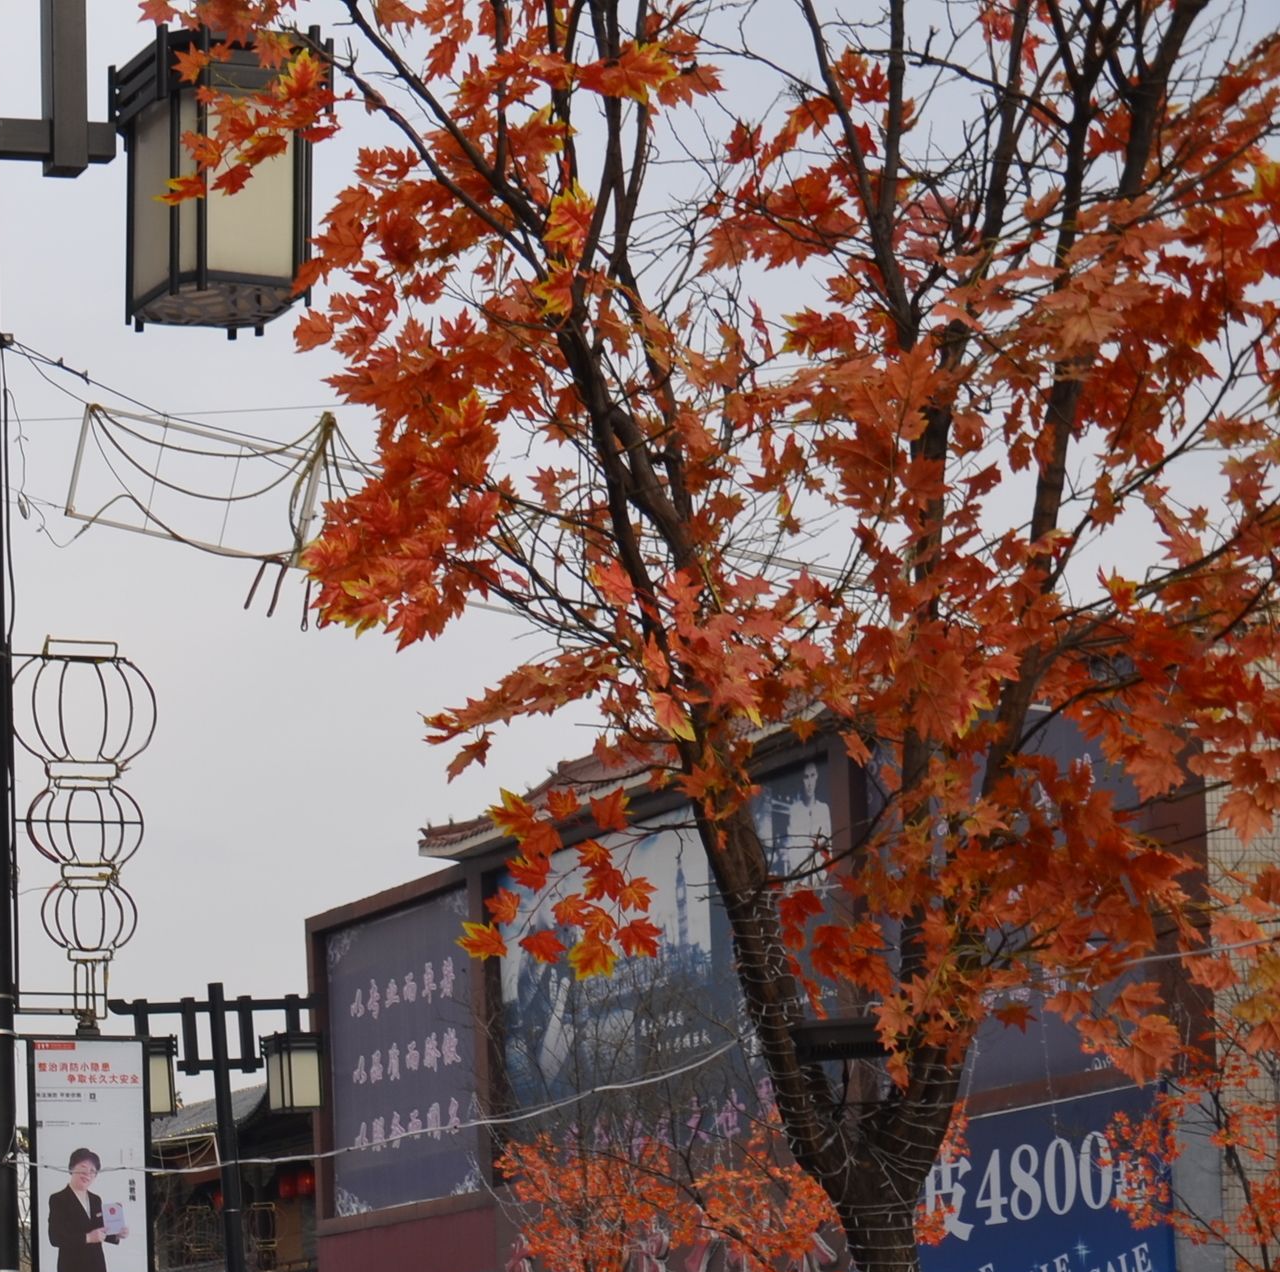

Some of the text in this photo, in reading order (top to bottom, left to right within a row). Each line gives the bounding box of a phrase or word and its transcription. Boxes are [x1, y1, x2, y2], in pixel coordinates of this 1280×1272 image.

[38, 1062, 110, 1073] 整治消防小隐患
[67, 1074, 140, 1084] 争取长久大安全
